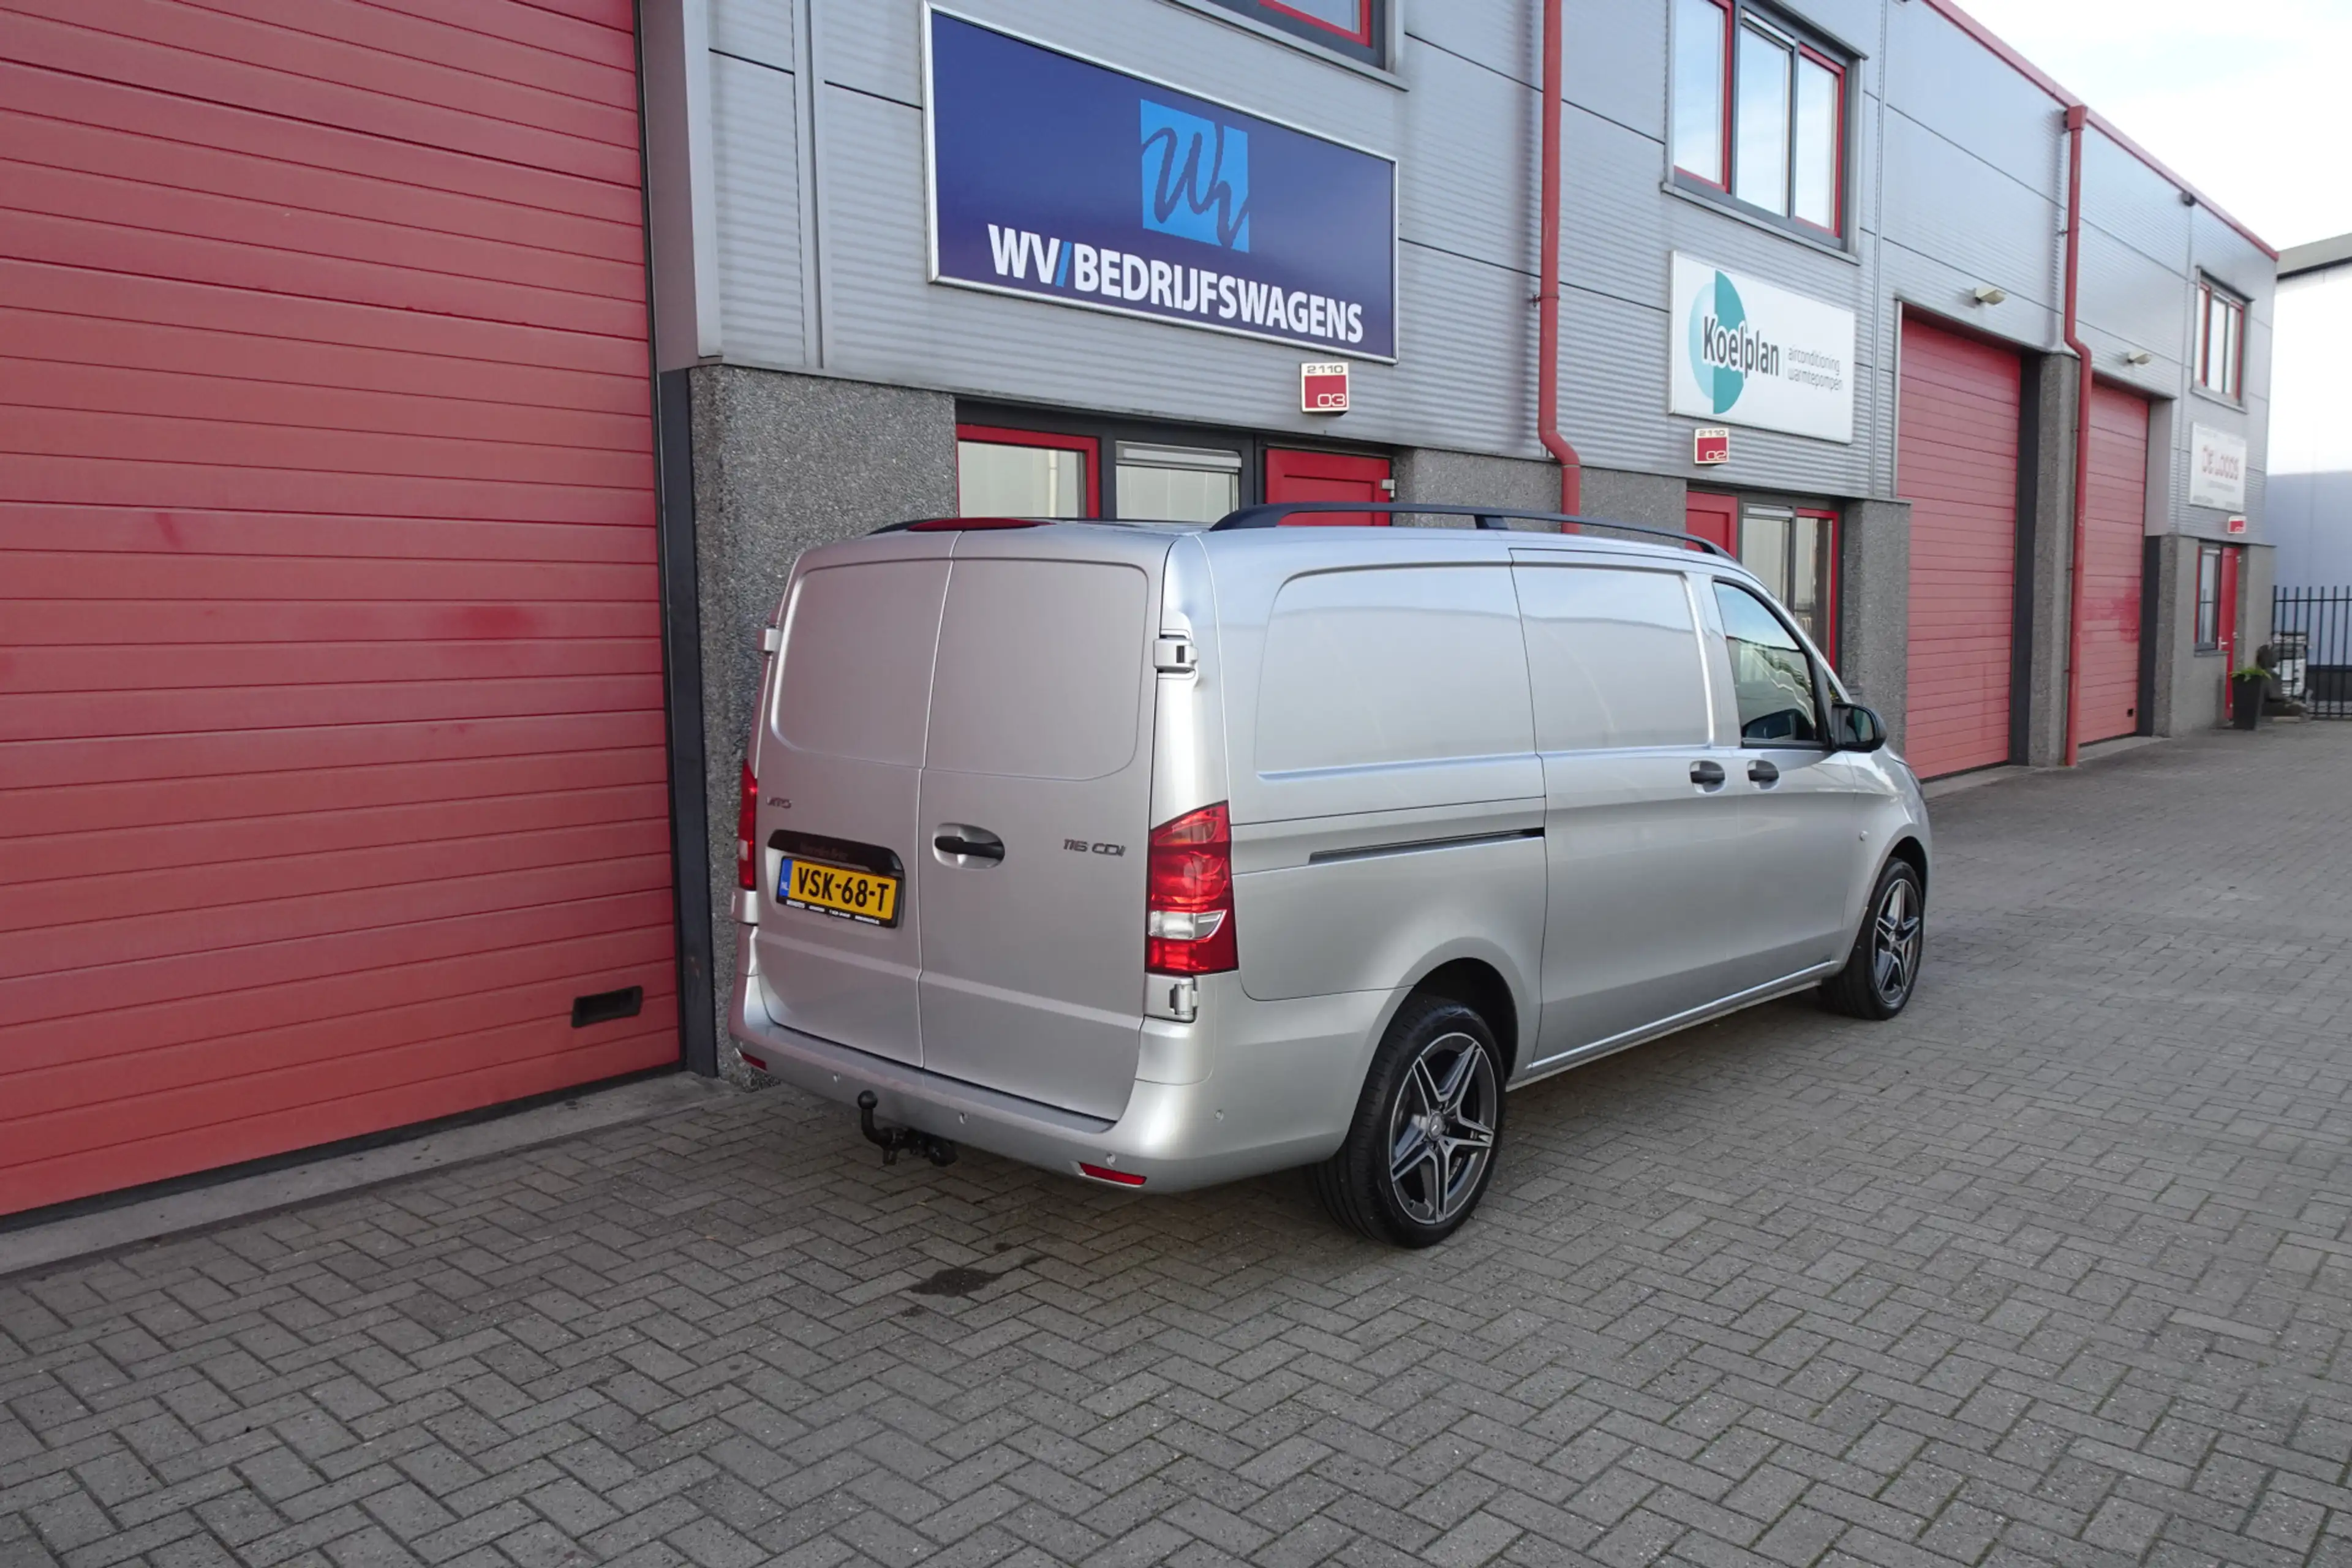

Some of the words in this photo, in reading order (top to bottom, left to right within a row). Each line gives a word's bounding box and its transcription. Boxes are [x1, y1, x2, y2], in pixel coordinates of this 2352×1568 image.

[1703, 315, 1779, 379] Koelplan
[1306, 364, 1344, 374] 2110
[1317, 393, 1346, 407] 03
[1706, 450, 1727, 461] 02
[1091, 842, 1126, 858] CDI
[798, 867, 890, 912] VSK-68-T
